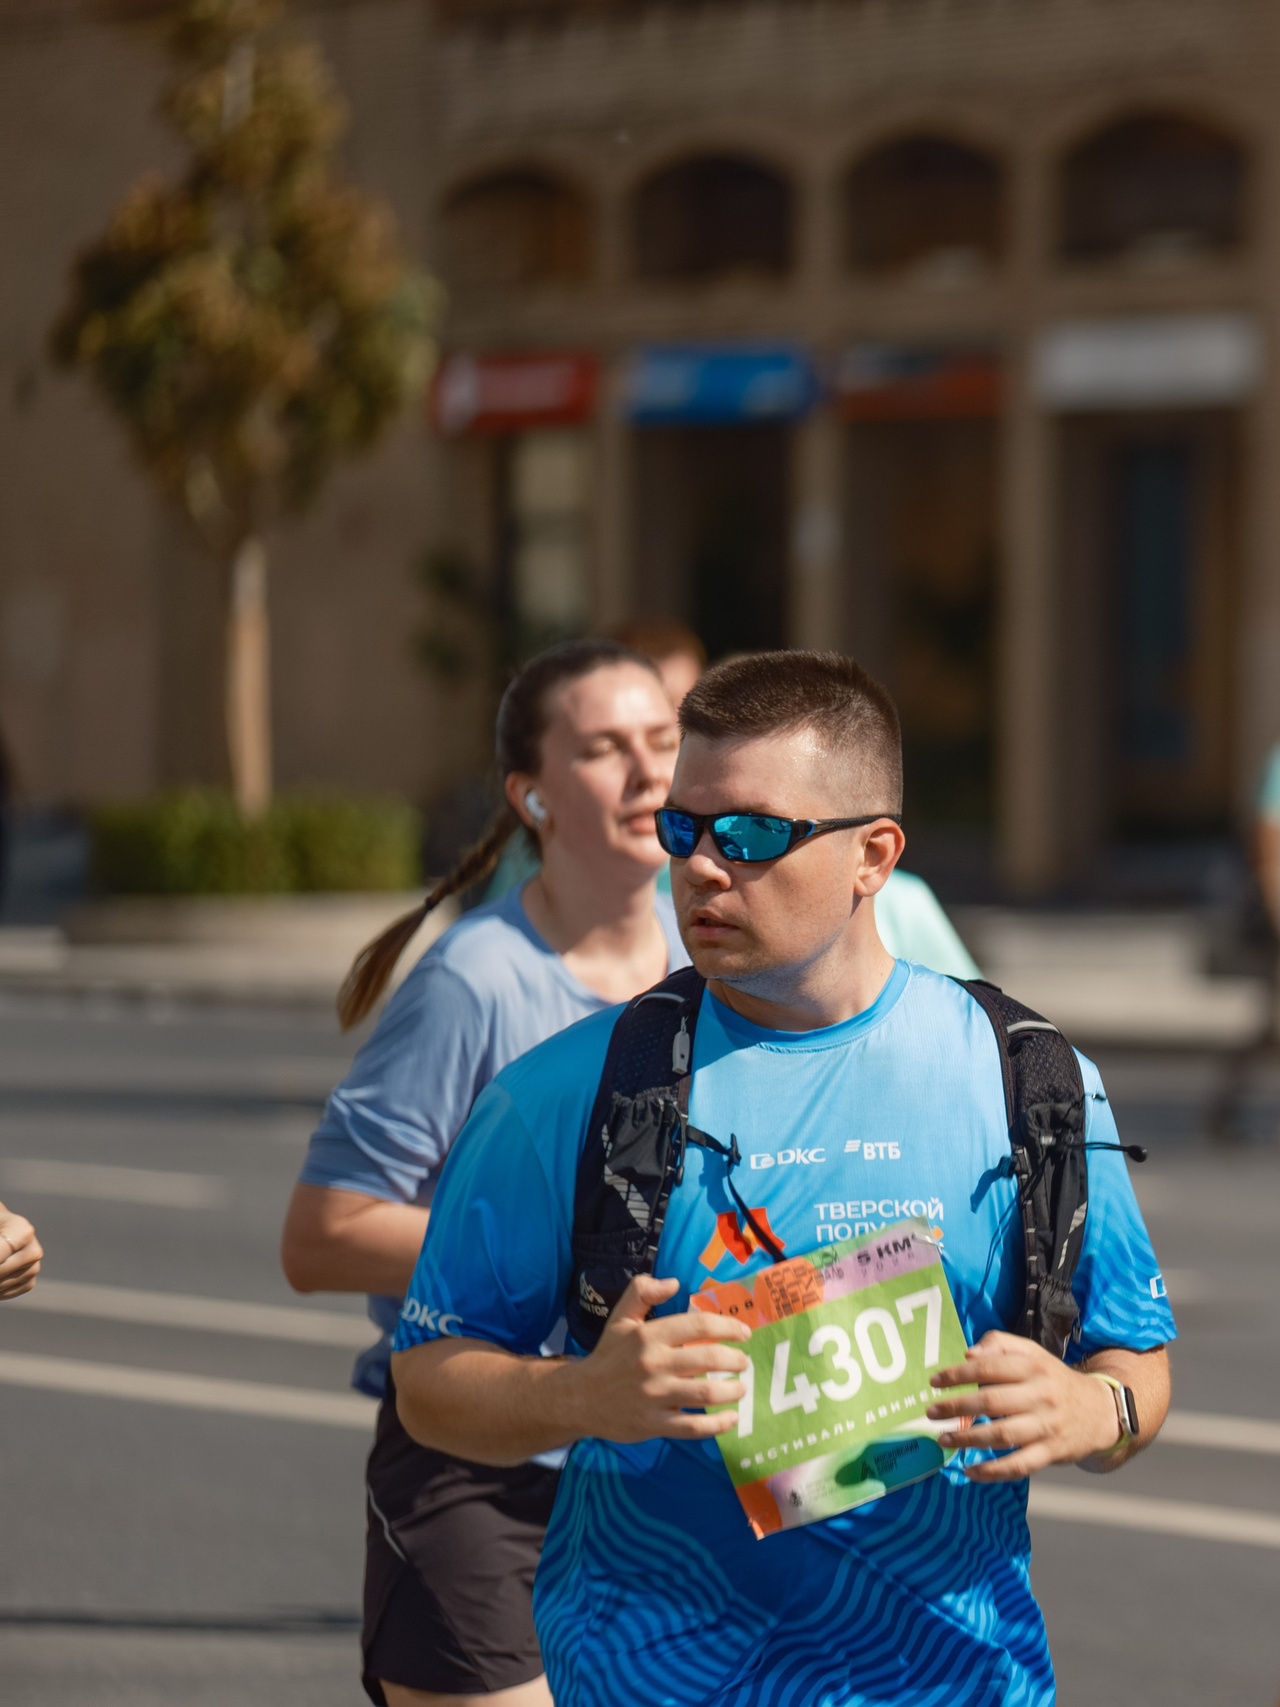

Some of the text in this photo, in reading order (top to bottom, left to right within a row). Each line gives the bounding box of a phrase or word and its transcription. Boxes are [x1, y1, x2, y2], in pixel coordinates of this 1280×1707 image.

[777, 1148, 826, 1165] DKC
[863, 1141, 901, 1160] ВТБ
[814, 1197, 943, 1221] ТВЕРСКОЙ
[876, 1236, 911, 1259] КМ
[401, 1297, 463, 1338] DKC
[740, 1387, 949, 1469] ФЕСТИВАЛЬ ДВИЖЕН
